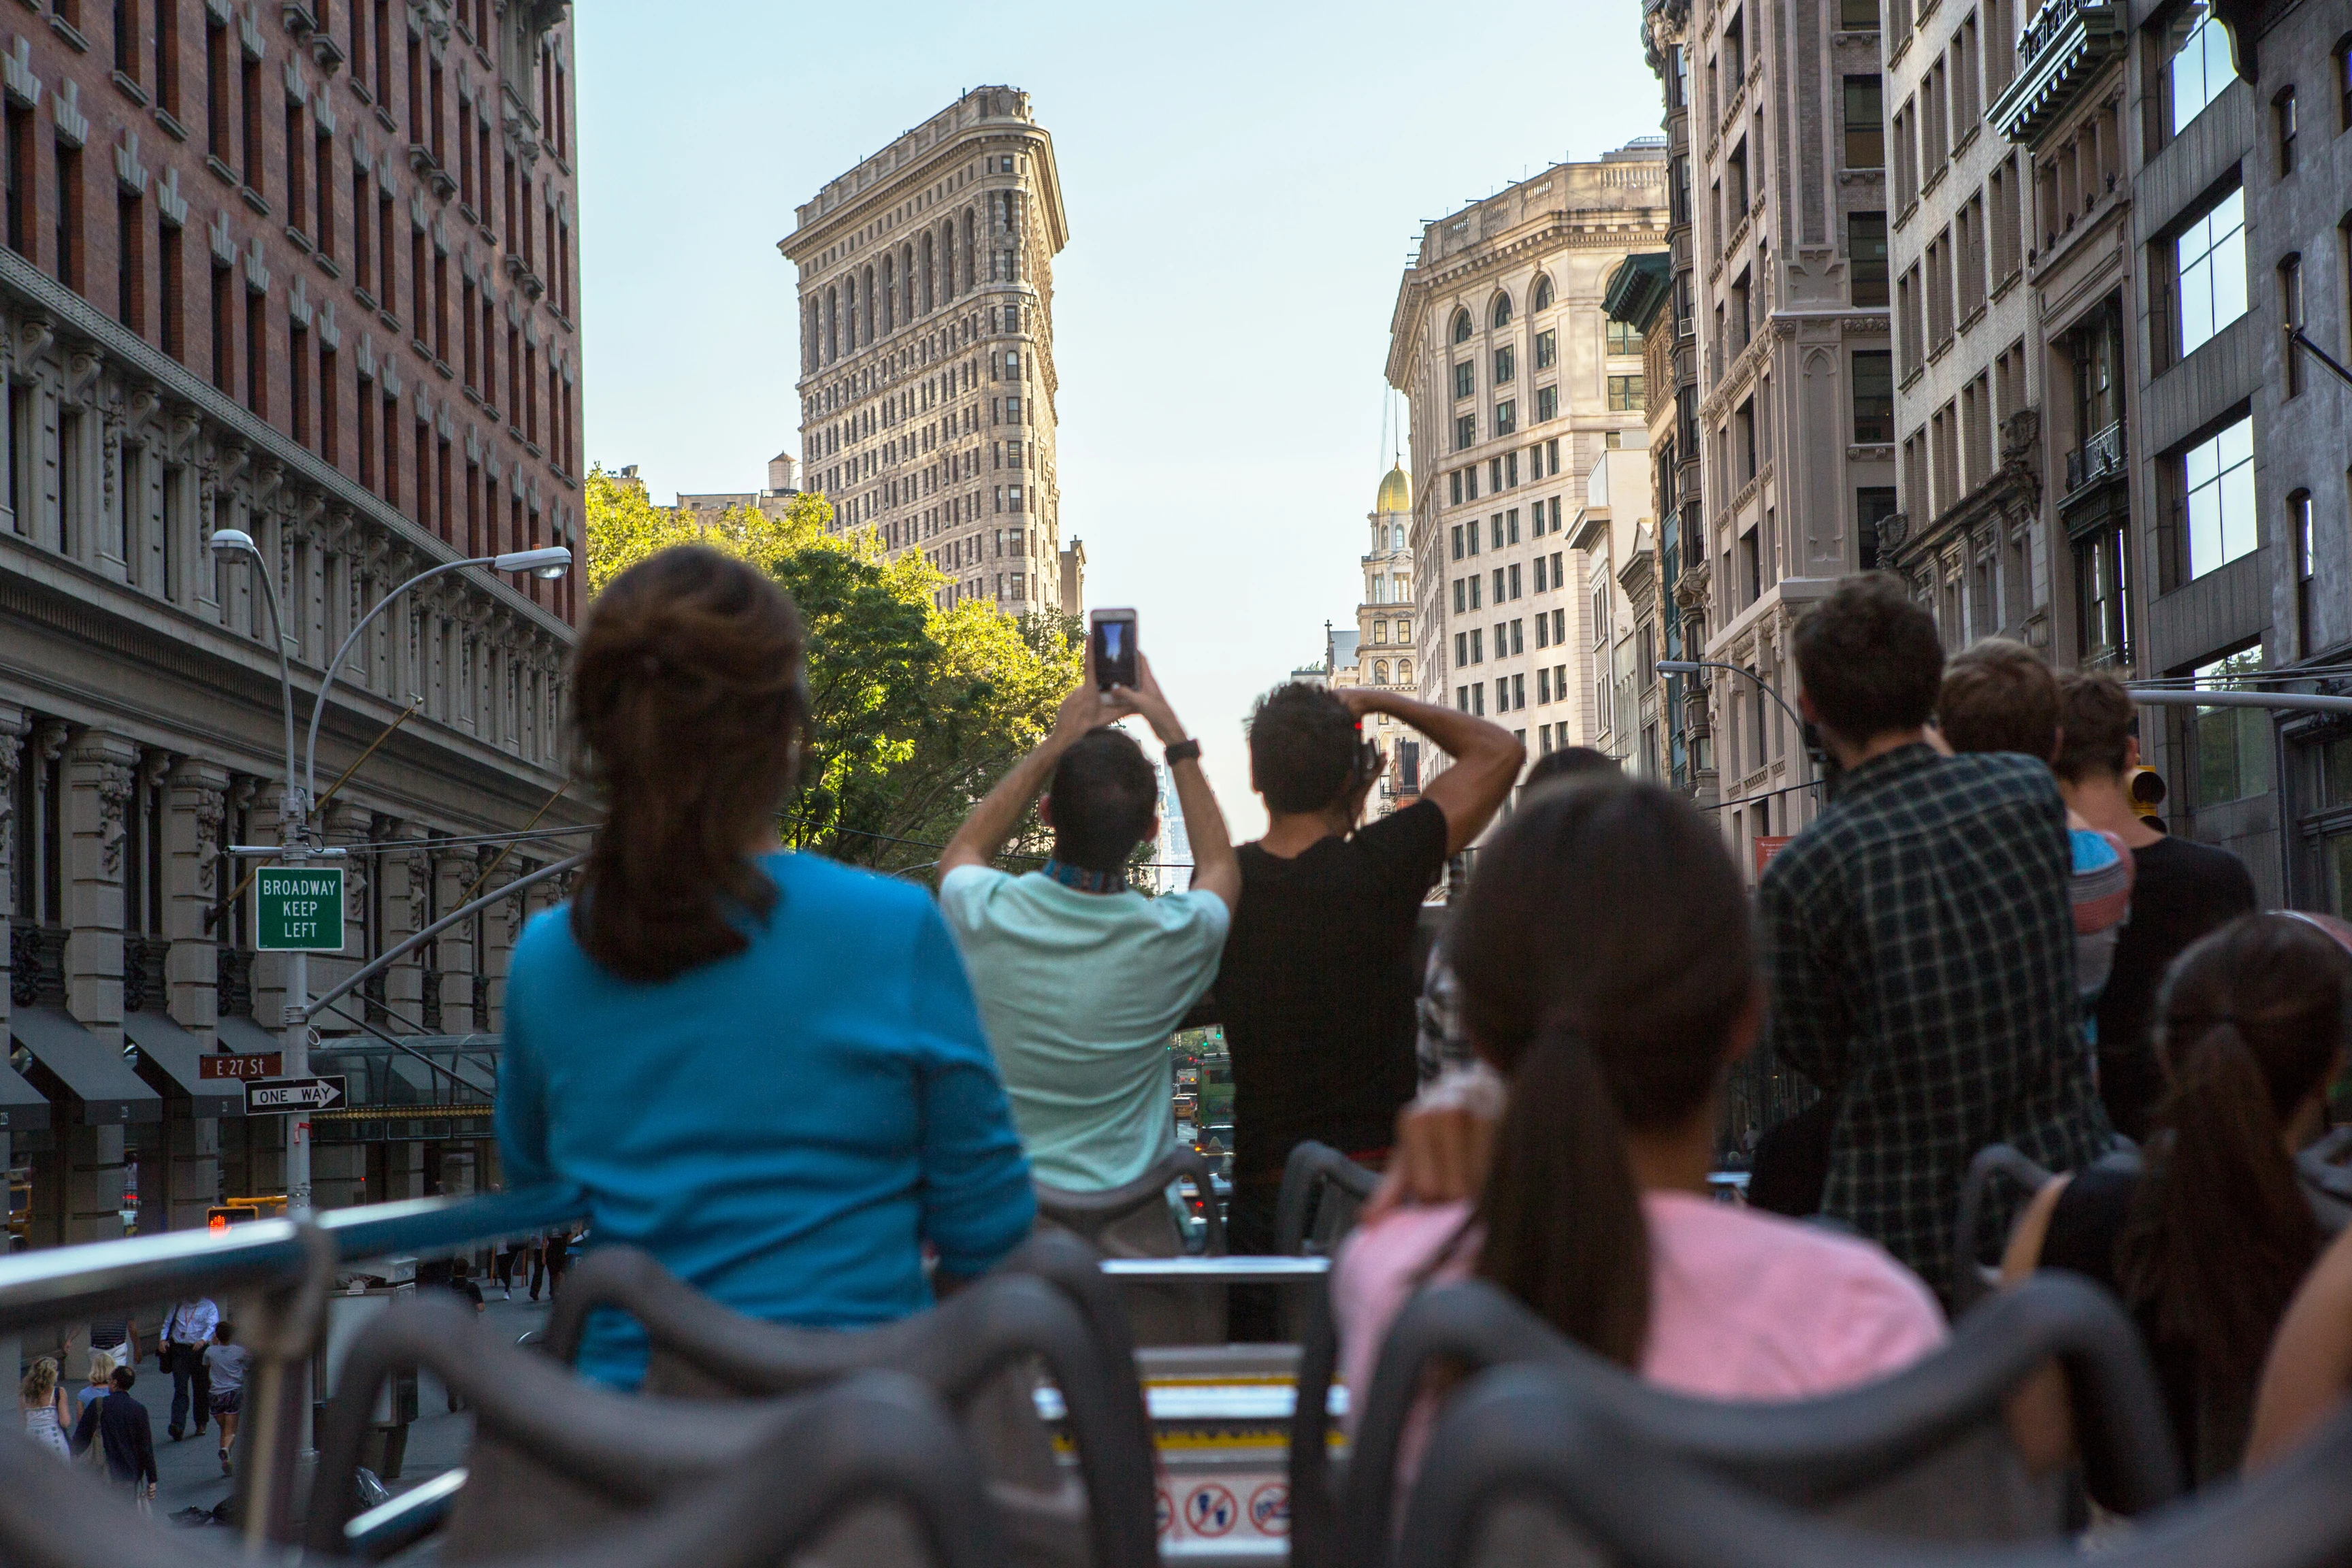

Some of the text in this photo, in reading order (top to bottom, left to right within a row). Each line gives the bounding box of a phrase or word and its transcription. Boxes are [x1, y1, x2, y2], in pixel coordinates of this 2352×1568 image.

[263, 880, 336, 896] BROADWAY
[283, 901, 318, 917] KEEP
[284, 922, 317, 938] LEFT
[216, 1058, 265, 1076] E 27 St
[260, 1087, 331, 1103] ONE WAY
